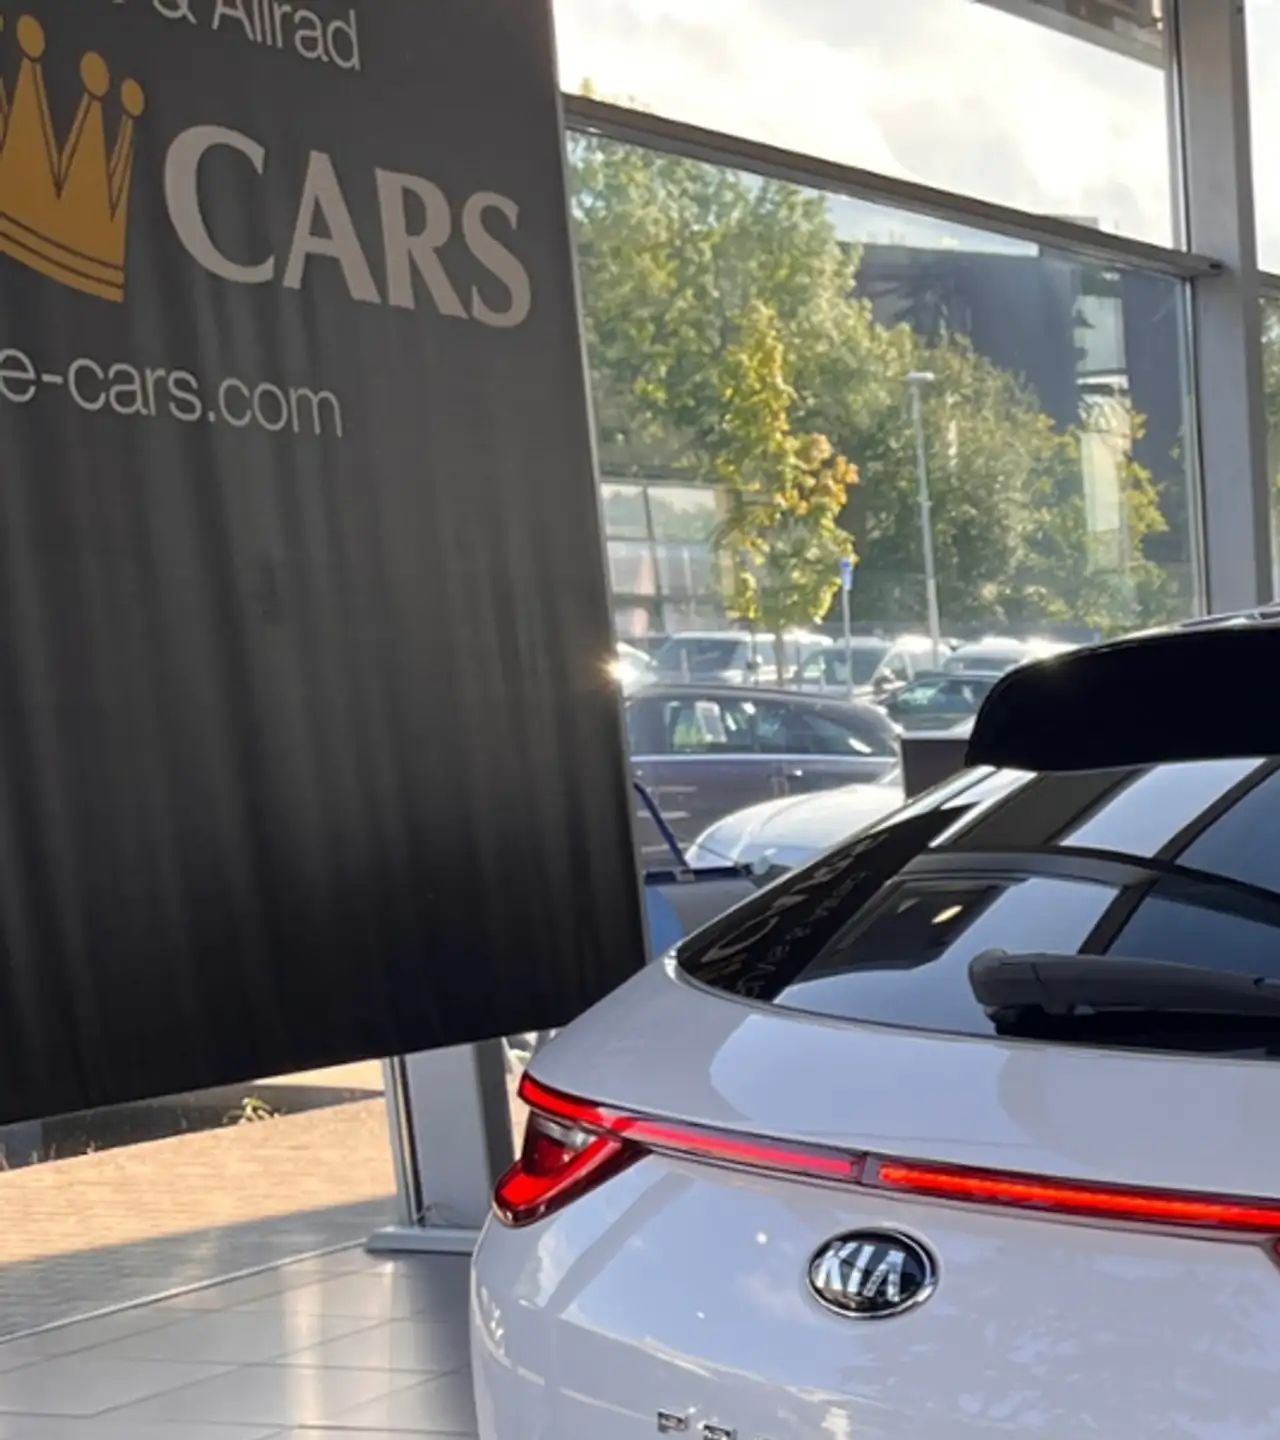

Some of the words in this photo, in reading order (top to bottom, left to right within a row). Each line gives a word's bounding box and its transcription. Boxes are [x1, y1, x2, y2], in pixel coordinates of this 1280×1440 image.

[211, 0, 361, 71] Allrad
[163, 124, 533, 328] CARS
[814, 1240, 906, 1302] KIA
